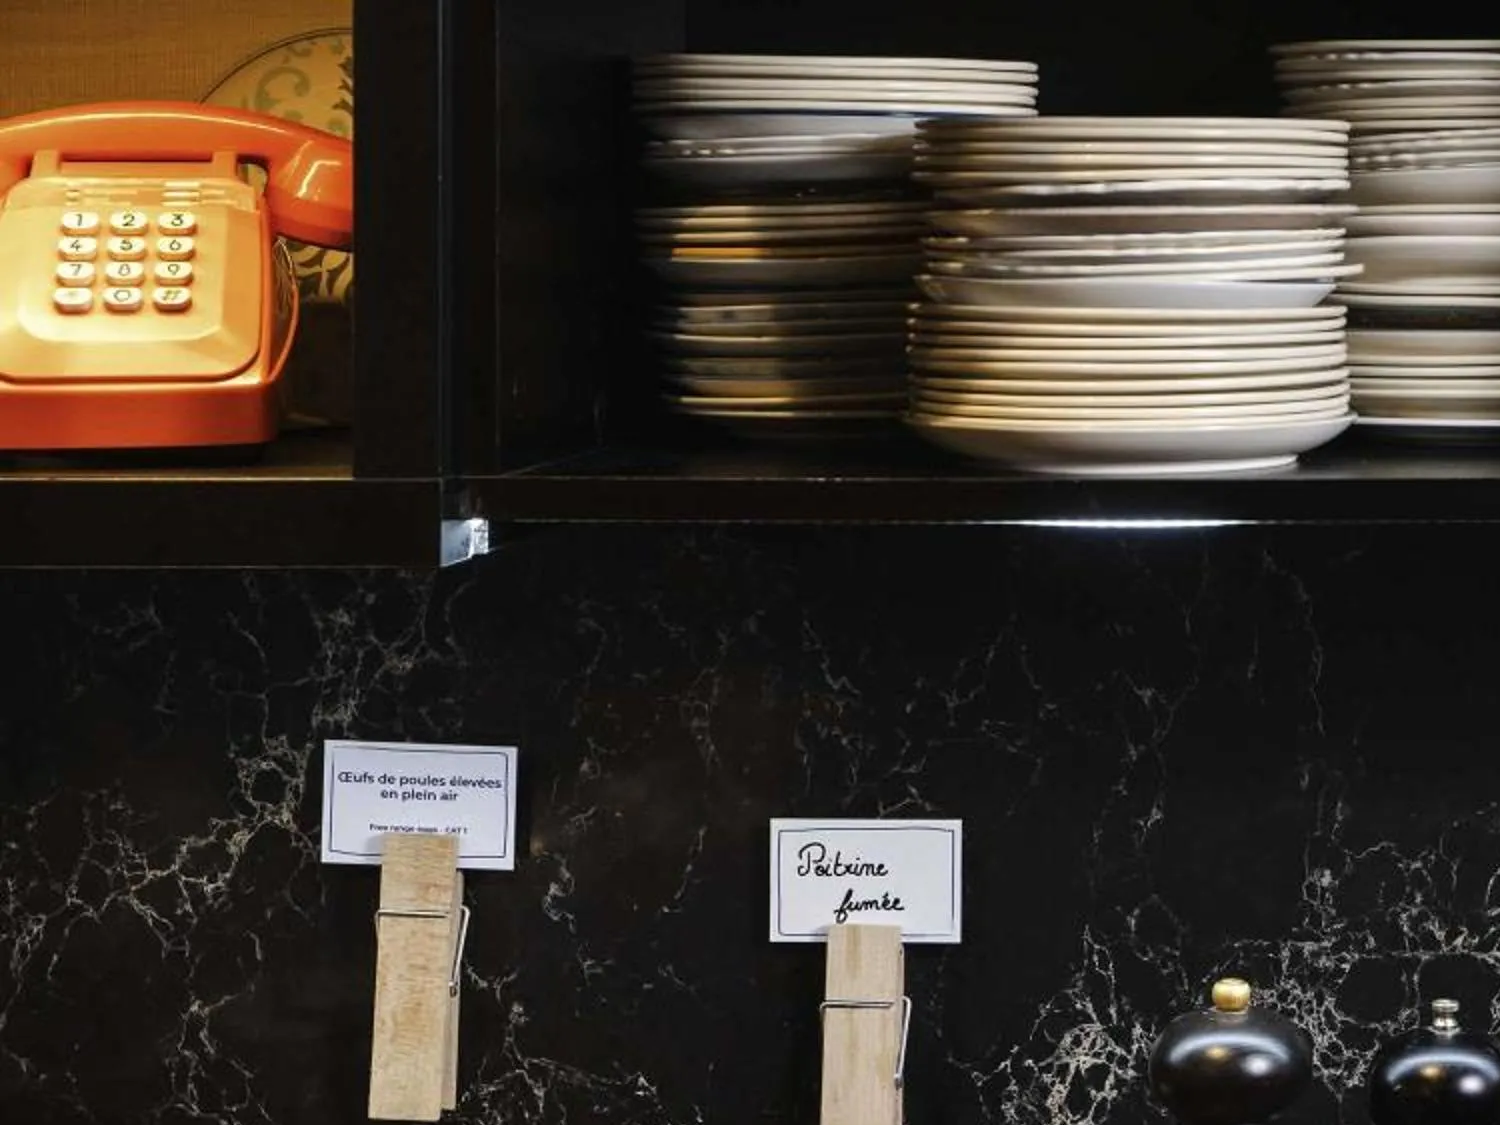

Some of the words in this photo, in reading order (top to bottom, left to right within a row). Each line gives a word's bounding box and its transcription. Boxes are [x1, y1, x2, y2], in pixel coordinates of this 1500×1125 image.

[75, 213, 83, 227] 1
[122, 213, 136, 227] 2
[170, 213, 185, 227] 3
[69, 239, 82, 252] 4
[120, 239, 133, 251] 5
[169, 239, 182, 252] 6
[69, 263, 83, 276] 7
[167, 263, 181, 276] 9
[377, 773, 397, 785] de
[399, 775, 447, 788] poules
[449, 776, 503, 789] élevées
[380, 790, 399, 800] en
[401, 789, 438, 803] plein
[439, 790, 459, 801] air
[797, 842, 889, 877] Poitrine
[833, 888, 905, 924] fumée
